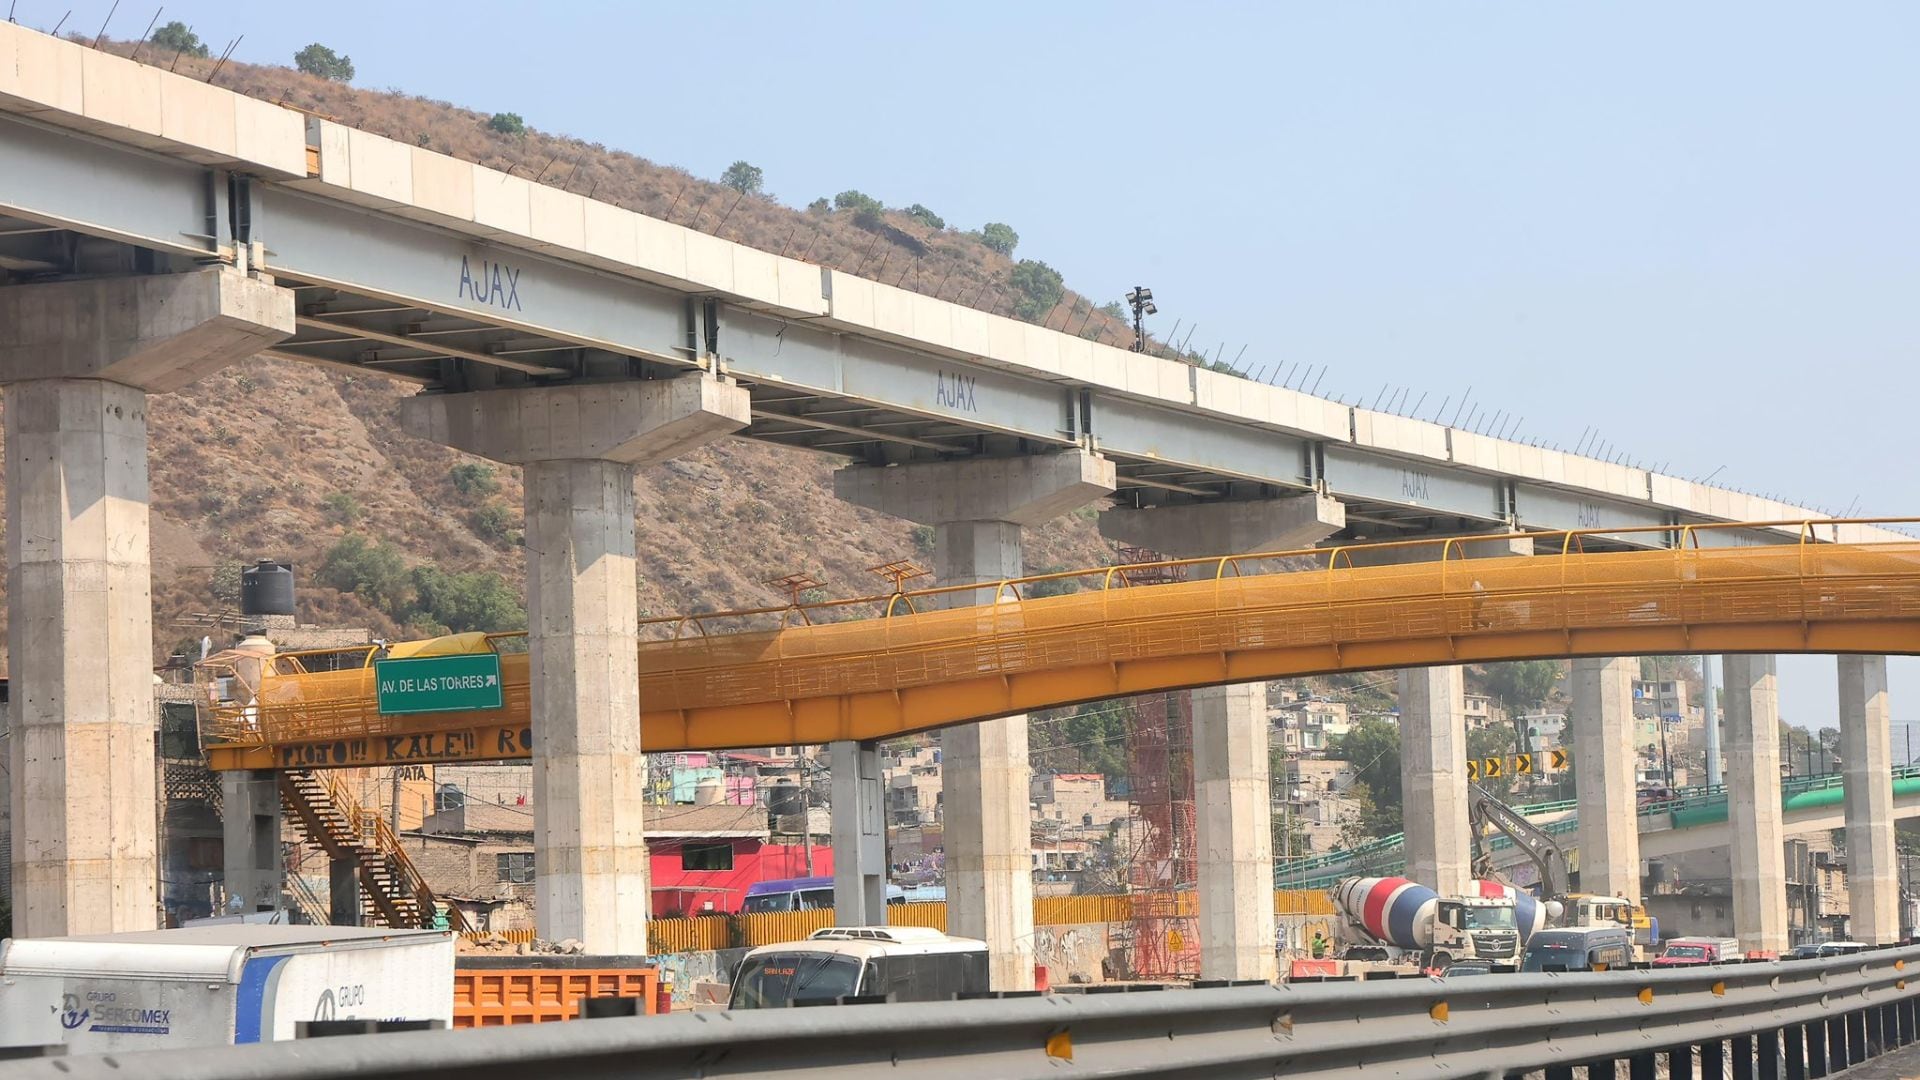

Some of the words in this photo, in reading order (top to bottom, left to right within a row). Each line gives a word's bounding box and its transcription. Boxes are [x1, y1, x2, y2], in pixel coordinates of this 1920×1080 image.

[459, 255, 521, 312] AJAX
[937, 370, 976, 412] AJAX
[1402, 469, 1429, 500] AJAX
[381, 681, 398, 694] AV.
[400, 680, 415, 692] DE
[417, 678, 438, 691] LAS
[440, 675, 484, 690] TORRES
[1500, 813, 1526, 837] VOLVO
[86, 992, 117, 1002] GRUPO
[339, 985, 364, 1007] GRUPO
